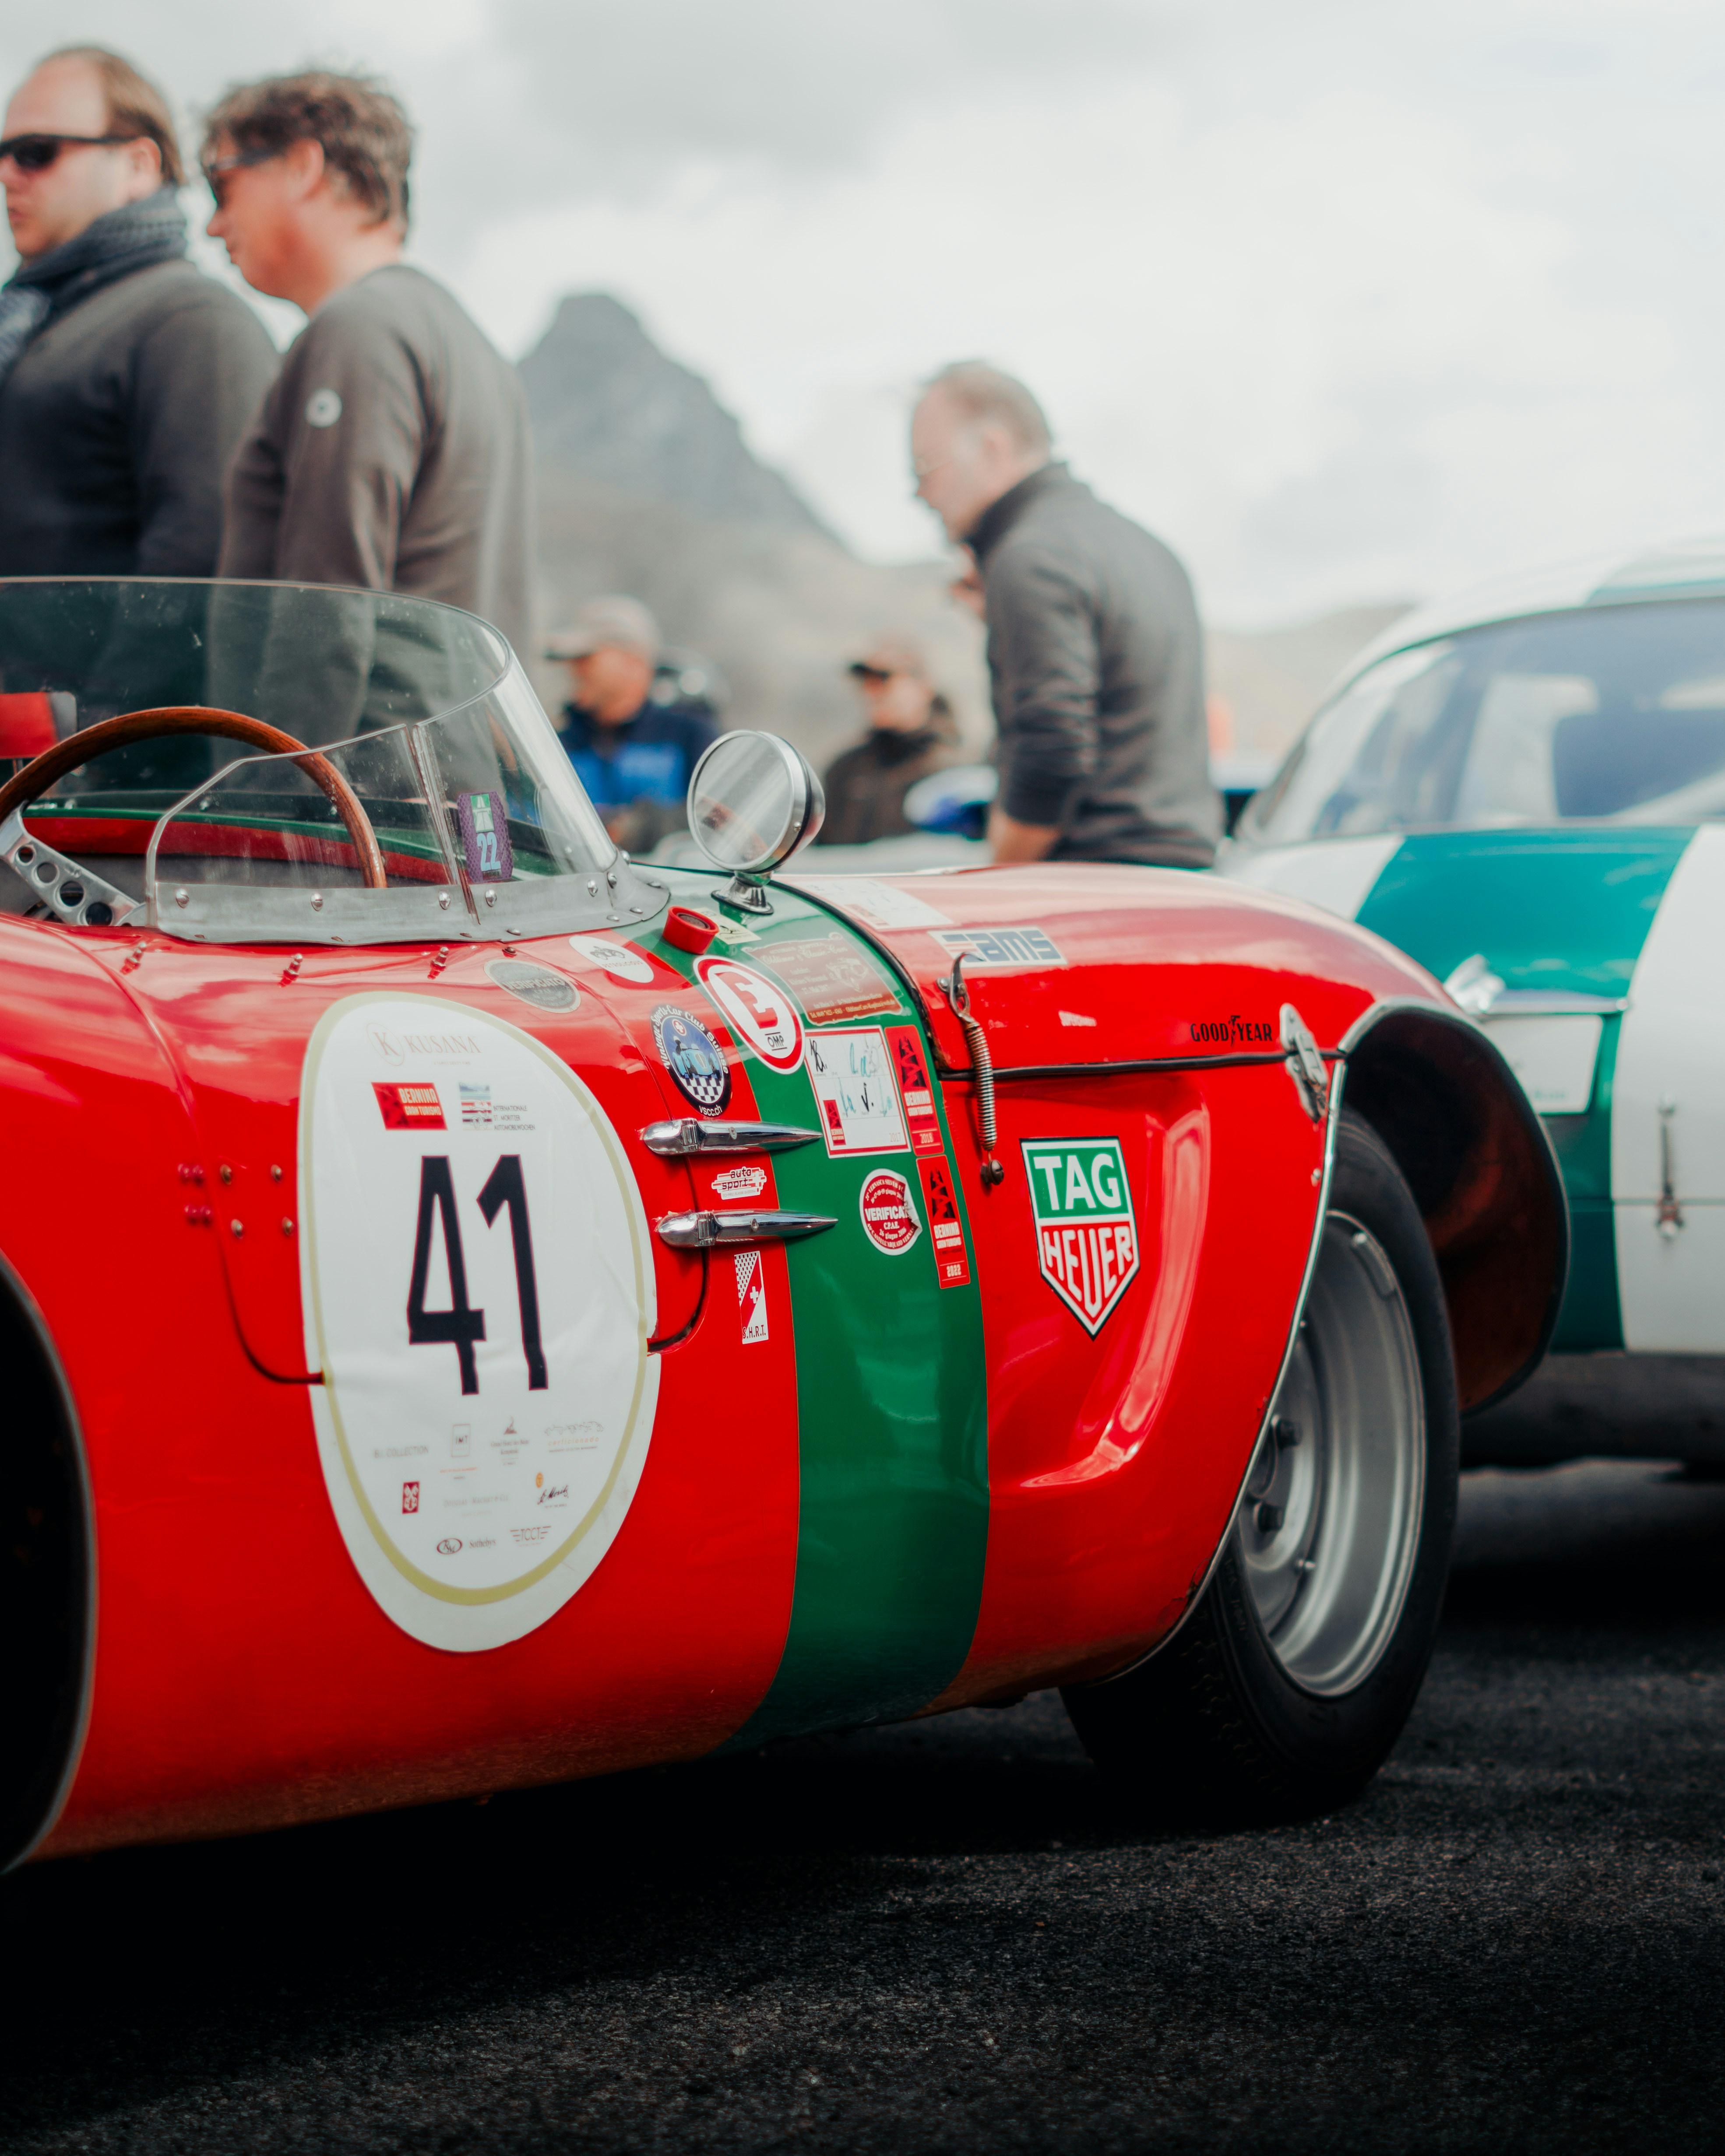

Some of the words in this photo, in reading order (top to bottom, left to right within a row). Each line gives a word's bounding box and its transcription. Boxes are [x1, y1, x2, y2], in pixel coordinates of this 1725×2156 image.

[477, 832, 502, 872] 22
[502, 977, 566, 991] VERIFICATO
[715, 971, 778, 1030] E
[402, 1035, 482, 1053] KUSANA
[654, 1027, 671, 1069] Vintage
[685, 1012, 705, 1031] Club
[707, 1031, 729, 1074] Suisse
[767, 1034, 785, 1048] OMP
[398, 1088, 439, 1103] BERNINA
[419, 1106, 442, 1115] TURISMO
[699, 1104, 723, 1116] vscc.ch
[889, 1133, 901, 1143] 2017
[920, 1133, 934, 1144] 2018
[730, 1168, 752, 1178] auto
[722, 1178, 748, 1191] sport
[869, 1179, 885, 1193] VERNASCA
[885, 1179, 898, 1189] SILVER
[1033, 1153, 1122, 1211] TAG
[880, 1229, 885, 1237] 26
[407, 1154, 549, 1396] 41
[946, 1264, 962, 1278] 2022
[1043, 1225, 1133, 1319] HEUER
[742, 1325, 766, 1339] S.H.R.T.
[548, 1436, 599, 1446] carficionado
[386, 1445, 429, 1457] COLLECTION
[469, 1538, 497, 1549] Sotheby's
